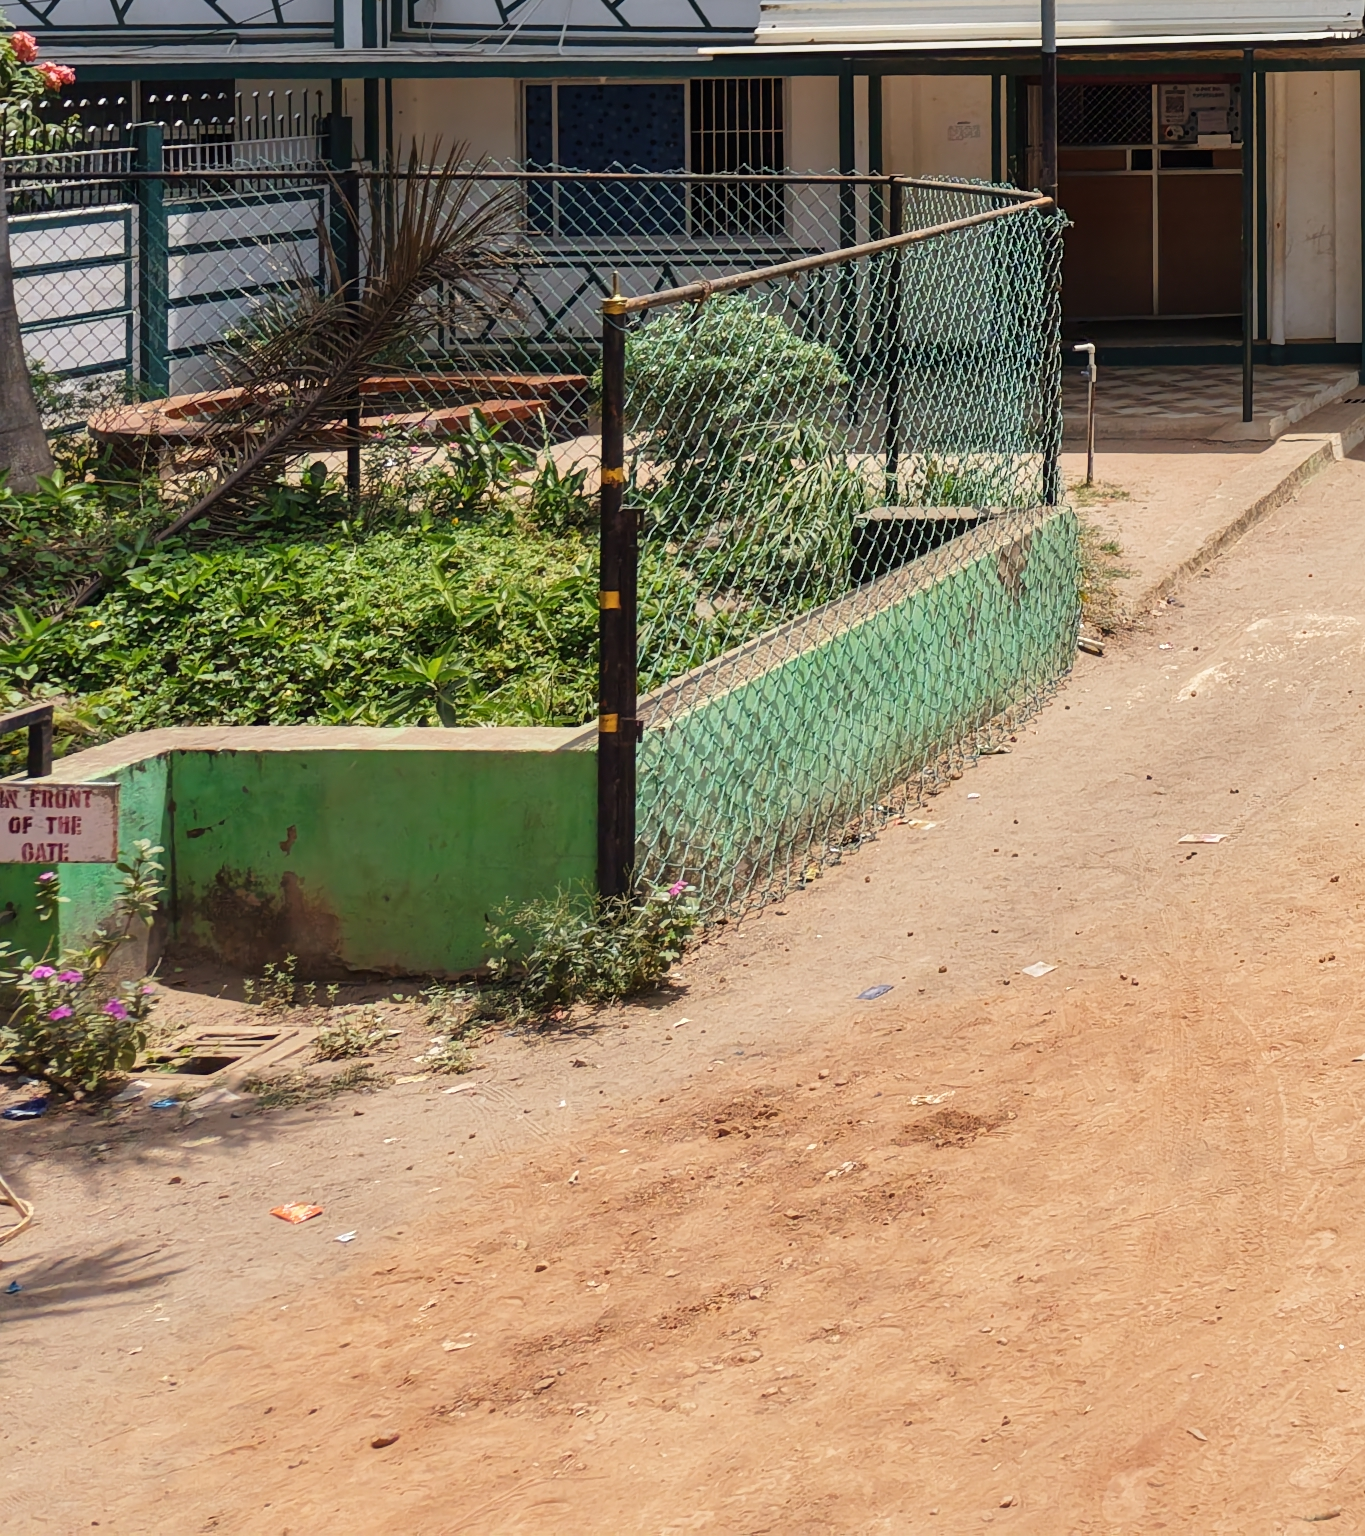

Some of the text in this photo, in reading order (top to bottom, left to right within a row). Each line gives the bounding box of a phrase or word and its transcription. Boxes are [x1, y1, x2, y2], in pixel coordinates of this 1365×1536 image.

[30, 789, 93, 809] FRONT
[8, 816, 82, 835] OF THE
[22, 842, 69, 862] GATE
